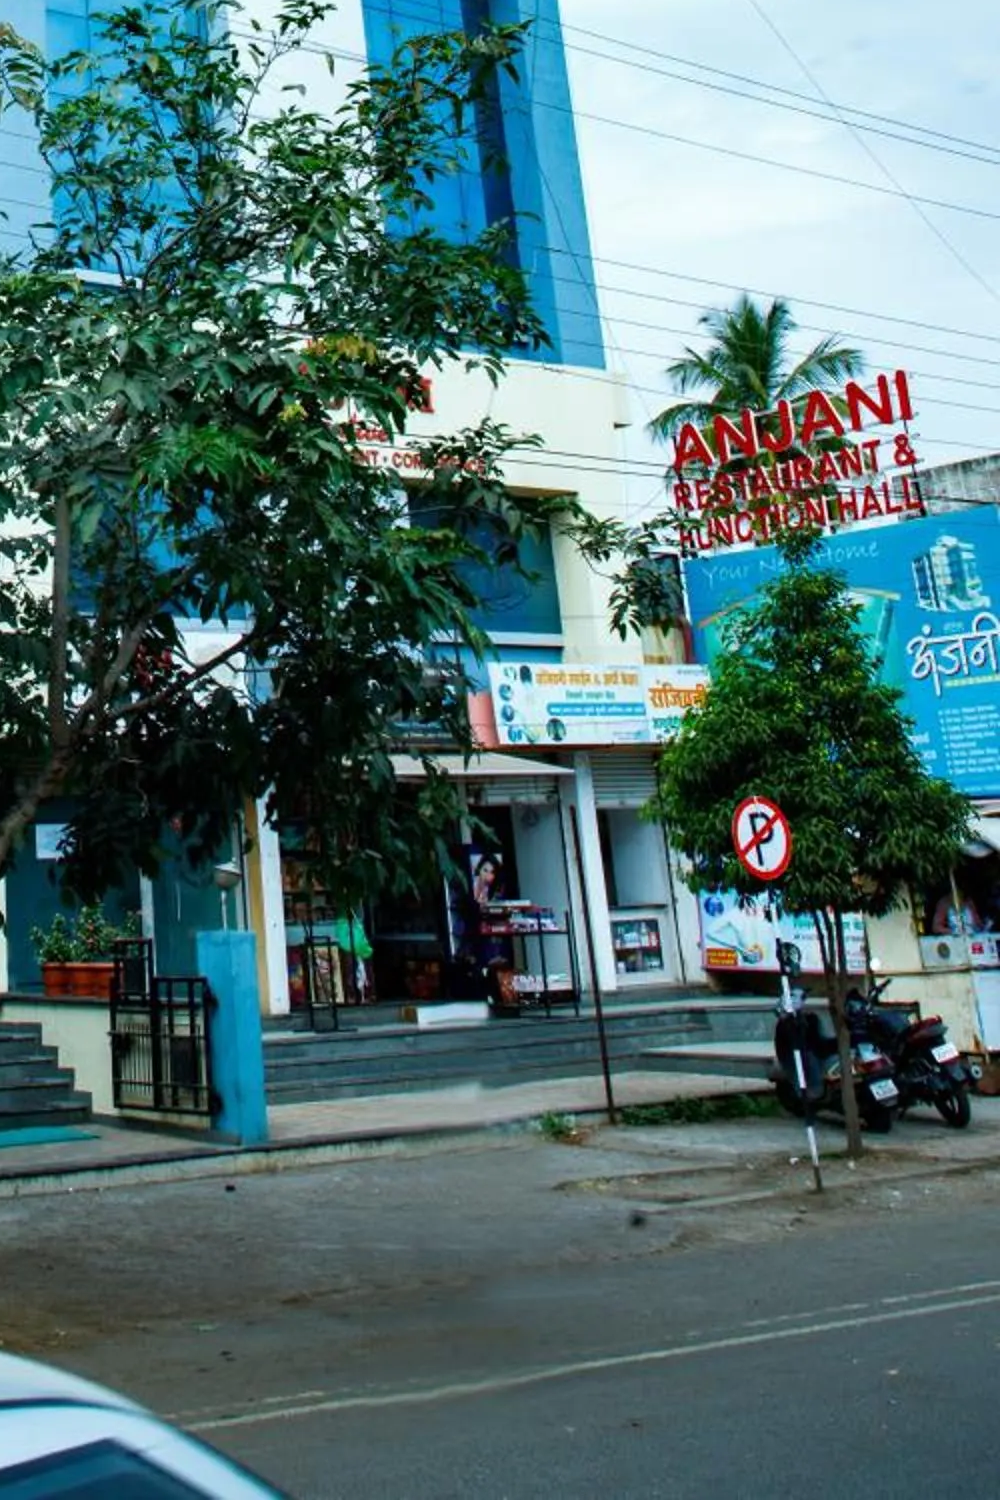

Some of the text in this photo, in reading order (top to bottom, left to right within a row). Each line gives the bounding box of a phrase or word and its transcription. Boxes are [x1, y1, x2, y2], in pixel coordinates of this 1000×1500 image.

[674, 370, 912, 474] ANJANI
[674, 434, 916, 512] RESTAURANT &
[837, 476, 925, 524] HALL
[759, 557, 790, 576] Ne
[816, 540, 879, 566] Home
[749, 812, 773, 866] P
